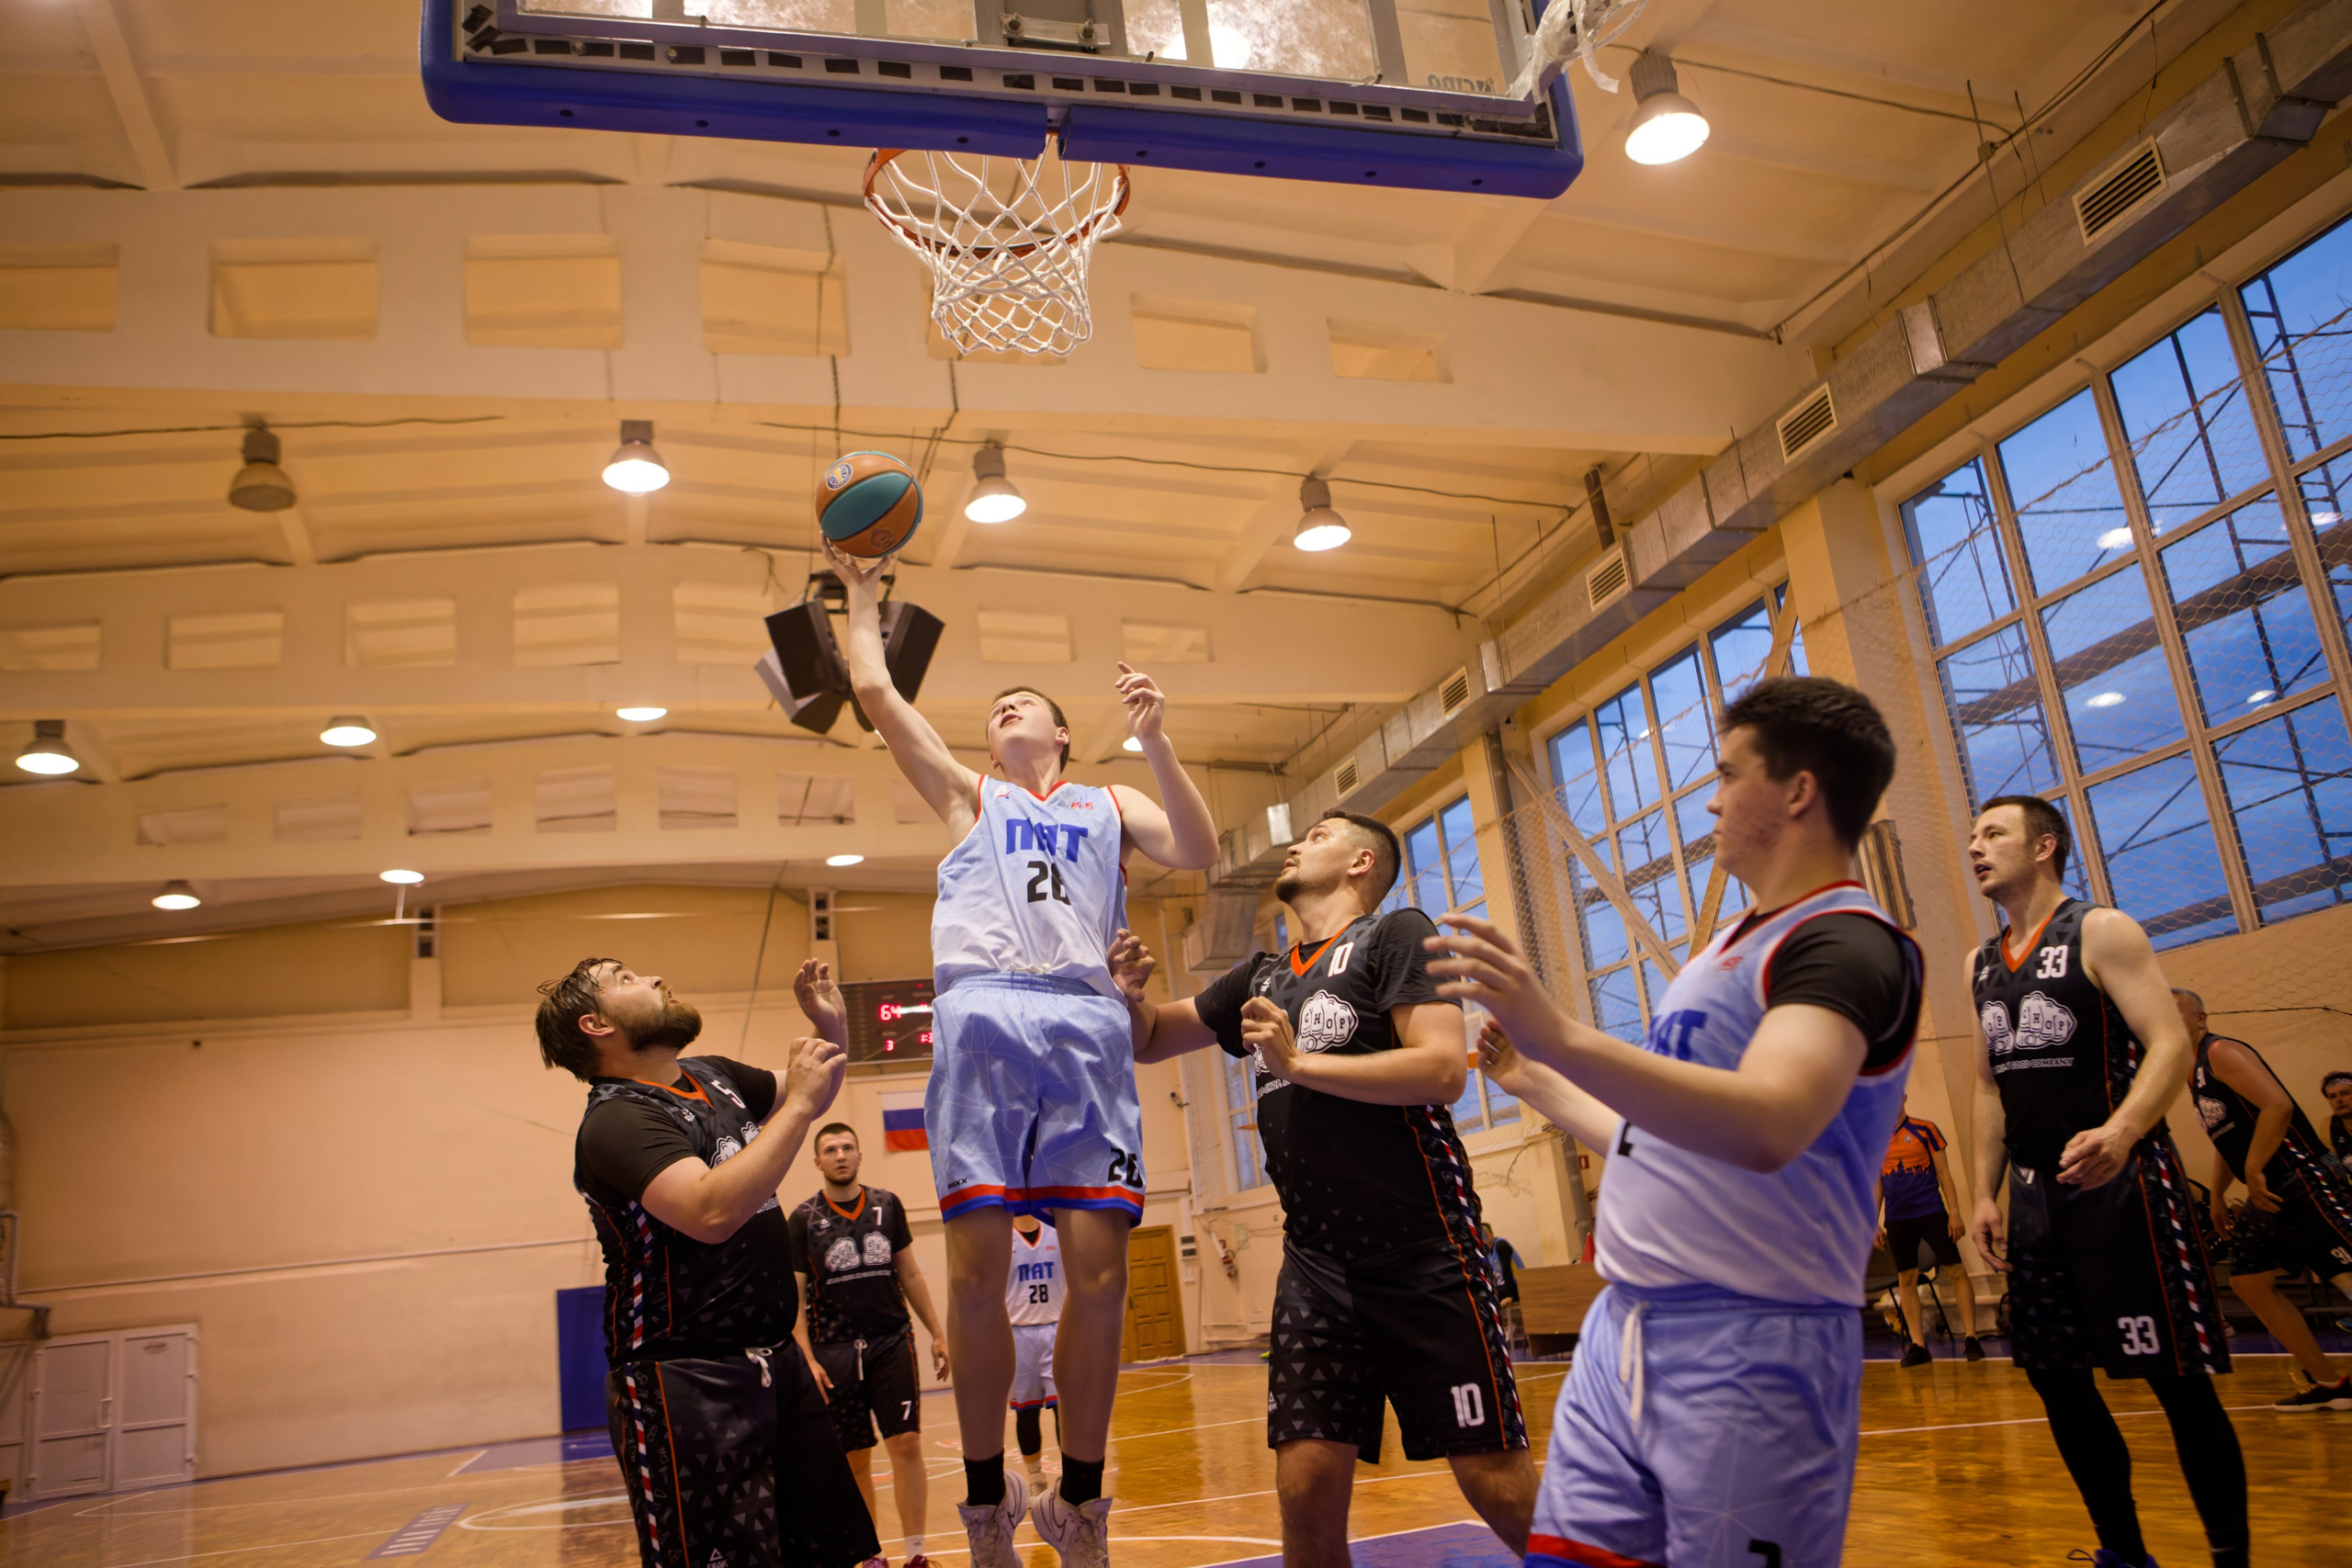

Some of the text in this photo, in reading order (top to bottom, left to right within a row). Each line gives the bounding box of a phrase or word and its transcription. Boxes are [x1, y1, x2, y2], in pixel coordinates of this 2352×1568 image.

[1328, 942, 1355, 977] 10
[2037, 944, 2069, 979] 33
[879, 1003, 902, 1021] 64
[1304, 1012, 1346, 1030] CHOP
[885, 1039, 896, 1052] 3
[2030, 1056, 2075, 1068] COMPANY
[710, 1079, 747, 1110] 5
[1108, 1146, 1144, 1189] 26
[872, 1206, 882, 1226] 7
[1018, 1261, 1055, 1282] ПАТ
[1028, 1283, 1049, 1304] 28
[2117, 1314, 2160, 1356] 33
[900, 1400, 912, 1421] 7
[1450, 1382, 1485, 1428] 10
